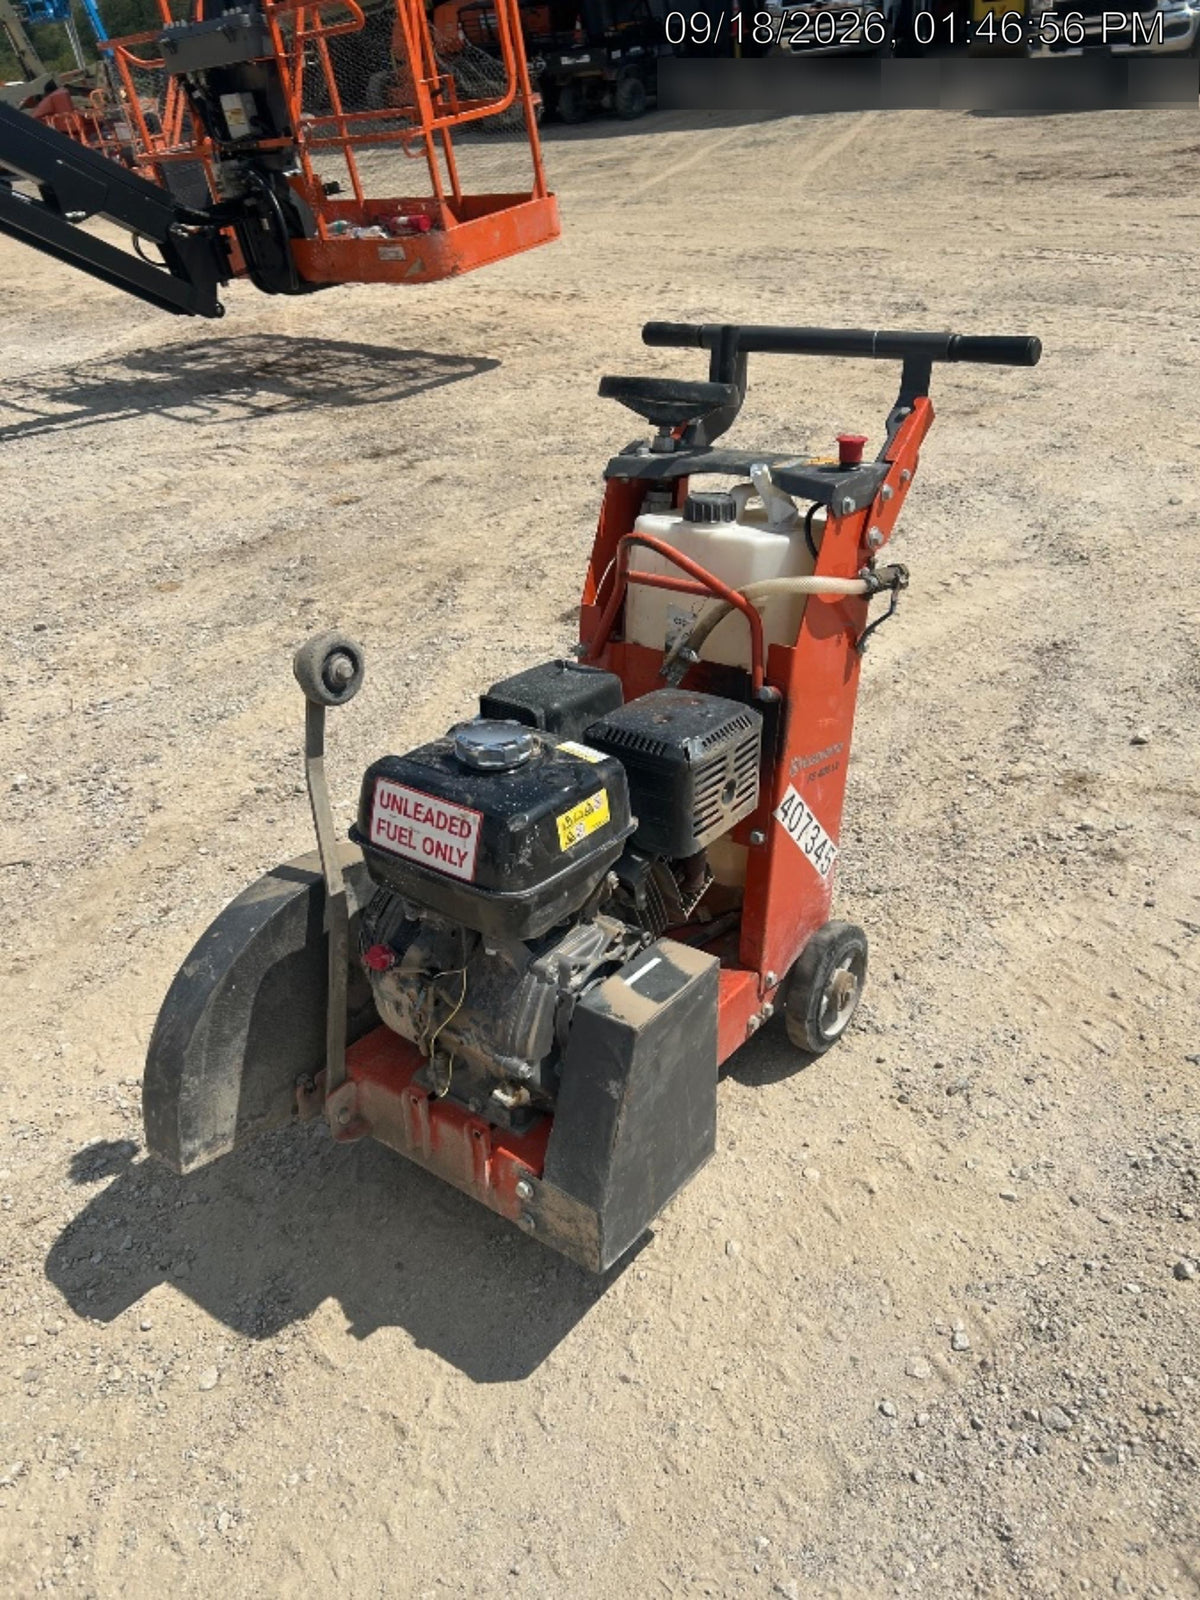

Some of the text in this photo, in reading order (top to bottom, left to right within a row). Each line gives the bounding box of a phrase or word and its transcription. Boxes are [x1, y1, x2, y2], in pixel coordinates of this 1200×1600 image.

[380, 789, 472, 839] UNLEADED
[780, 794, 837, 876] 407345
[377, 817, 468, 868] FUEL ONLY
